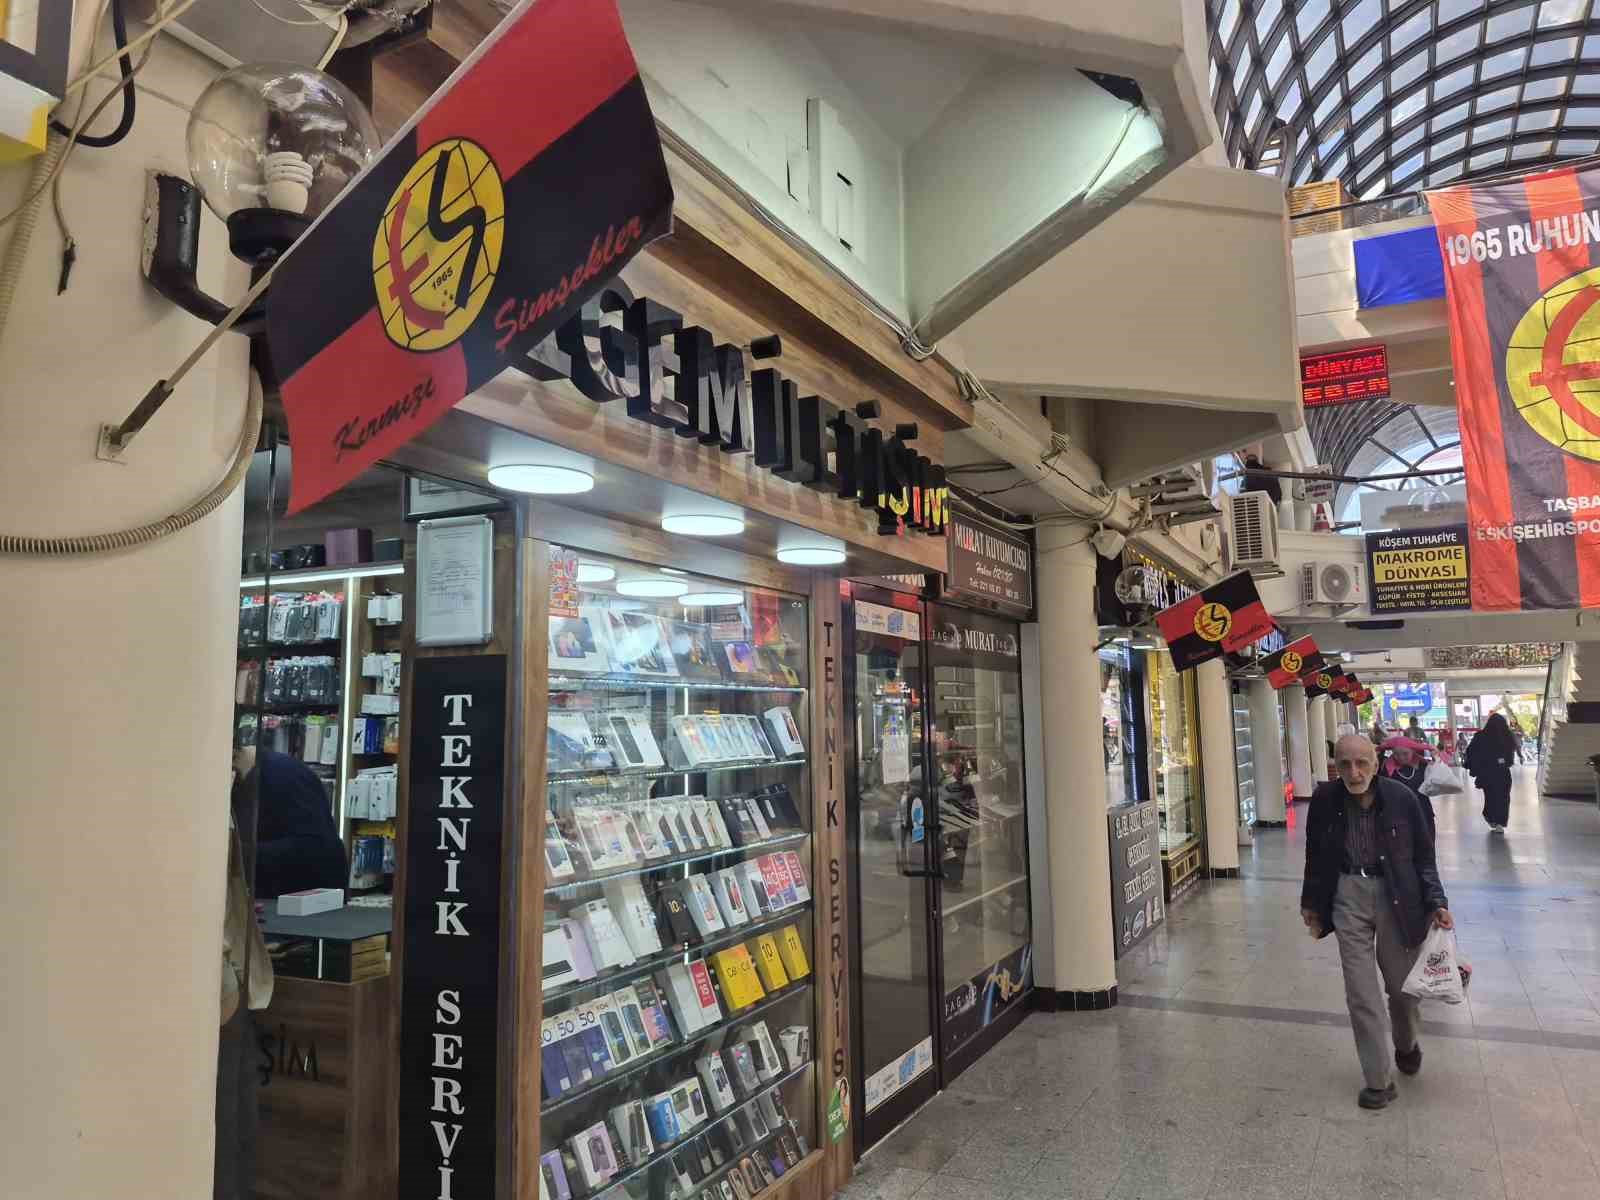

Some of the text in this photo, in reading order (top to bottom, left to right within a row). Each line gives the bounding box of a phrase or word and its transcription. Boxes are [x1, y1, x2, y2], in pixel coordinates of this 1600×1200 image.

[1446, 228, 1502, 267] 1965
[431, 267, 454, 290] 1965
[954, 522, 985, 555] MURAT
[1378, 532, 1457, 549] KÖŞEM TUHAFİYE
[1476, 519, 1600, 543] ESKİŞEHİRSPO
[1376, 548, 1463, 566] MAKROME
[1384, 564, 1456, 580] DÜNYASI
[964, 628, 995, 653] MURAT
[822, 621, 845, 1078] TEKNİK SERVİS
[429, 693, 474, 1200] TEKNİK SERVİ
